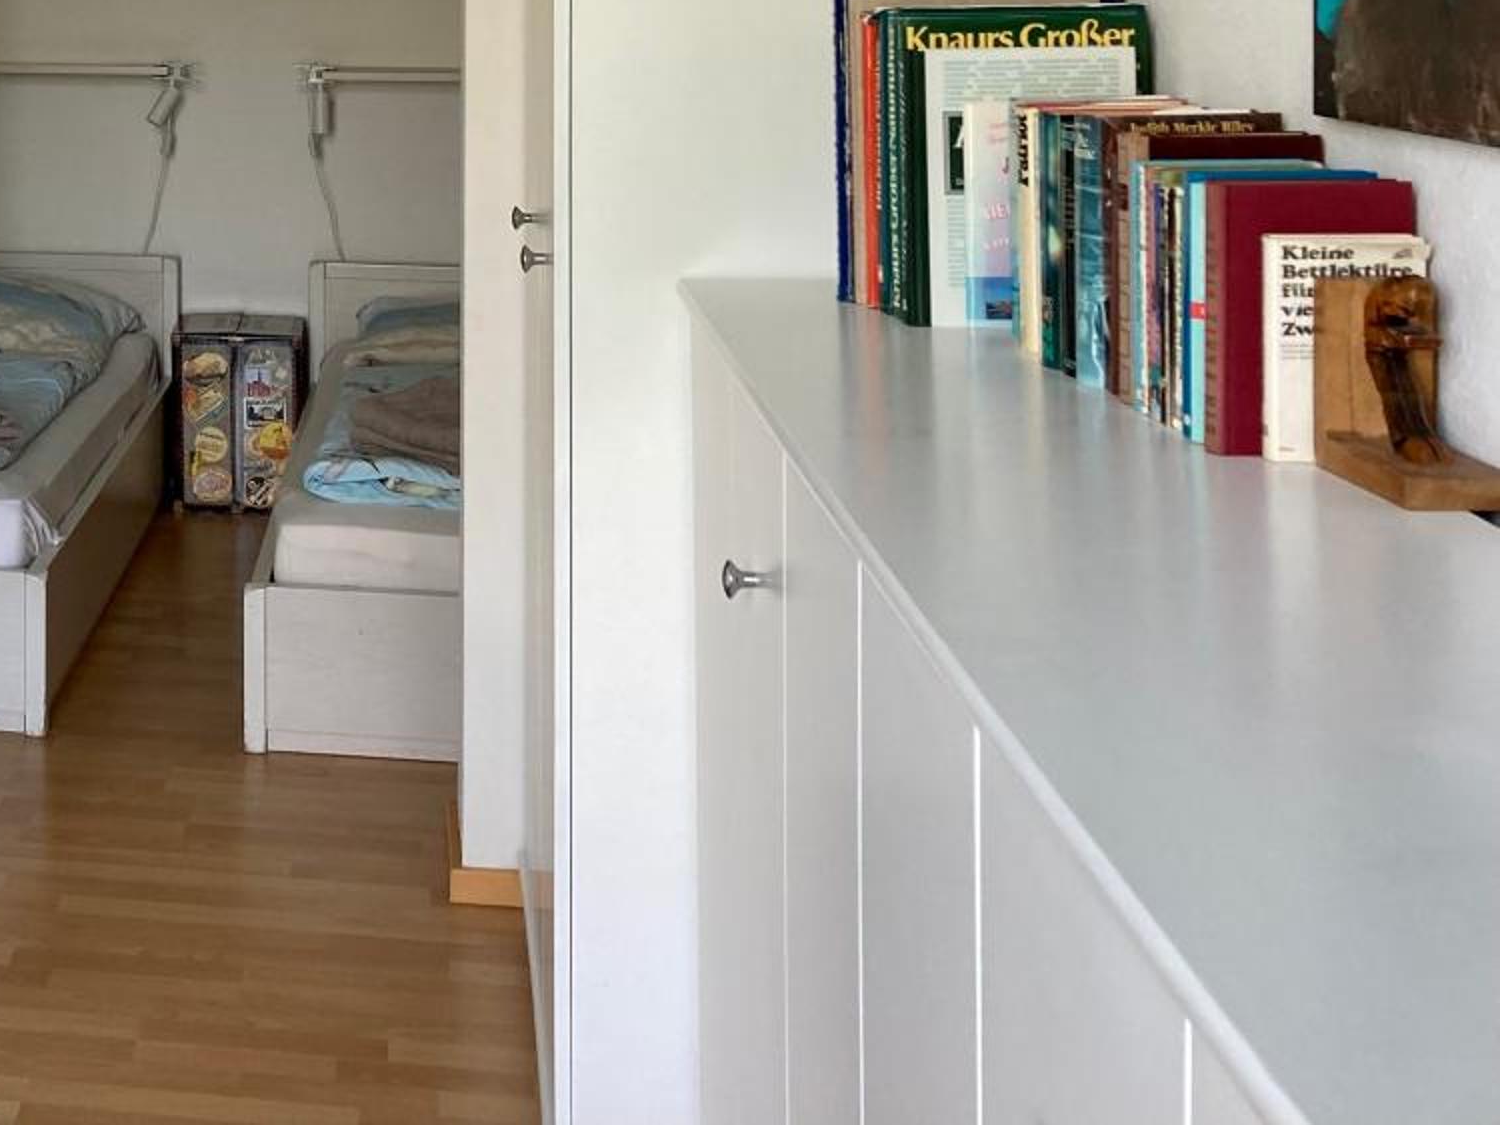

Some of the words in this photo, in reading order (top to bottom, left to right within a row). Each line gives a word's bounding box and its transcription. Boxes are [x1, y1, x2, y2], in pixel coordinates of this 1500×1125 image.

[905, 25, 1014, 52] Knaurs
[1019, 18, 1136, 48] Großer
[1281, 245, 1355, 260] Kleine
[1281, 263, 1414, 279] Bettlektüre
